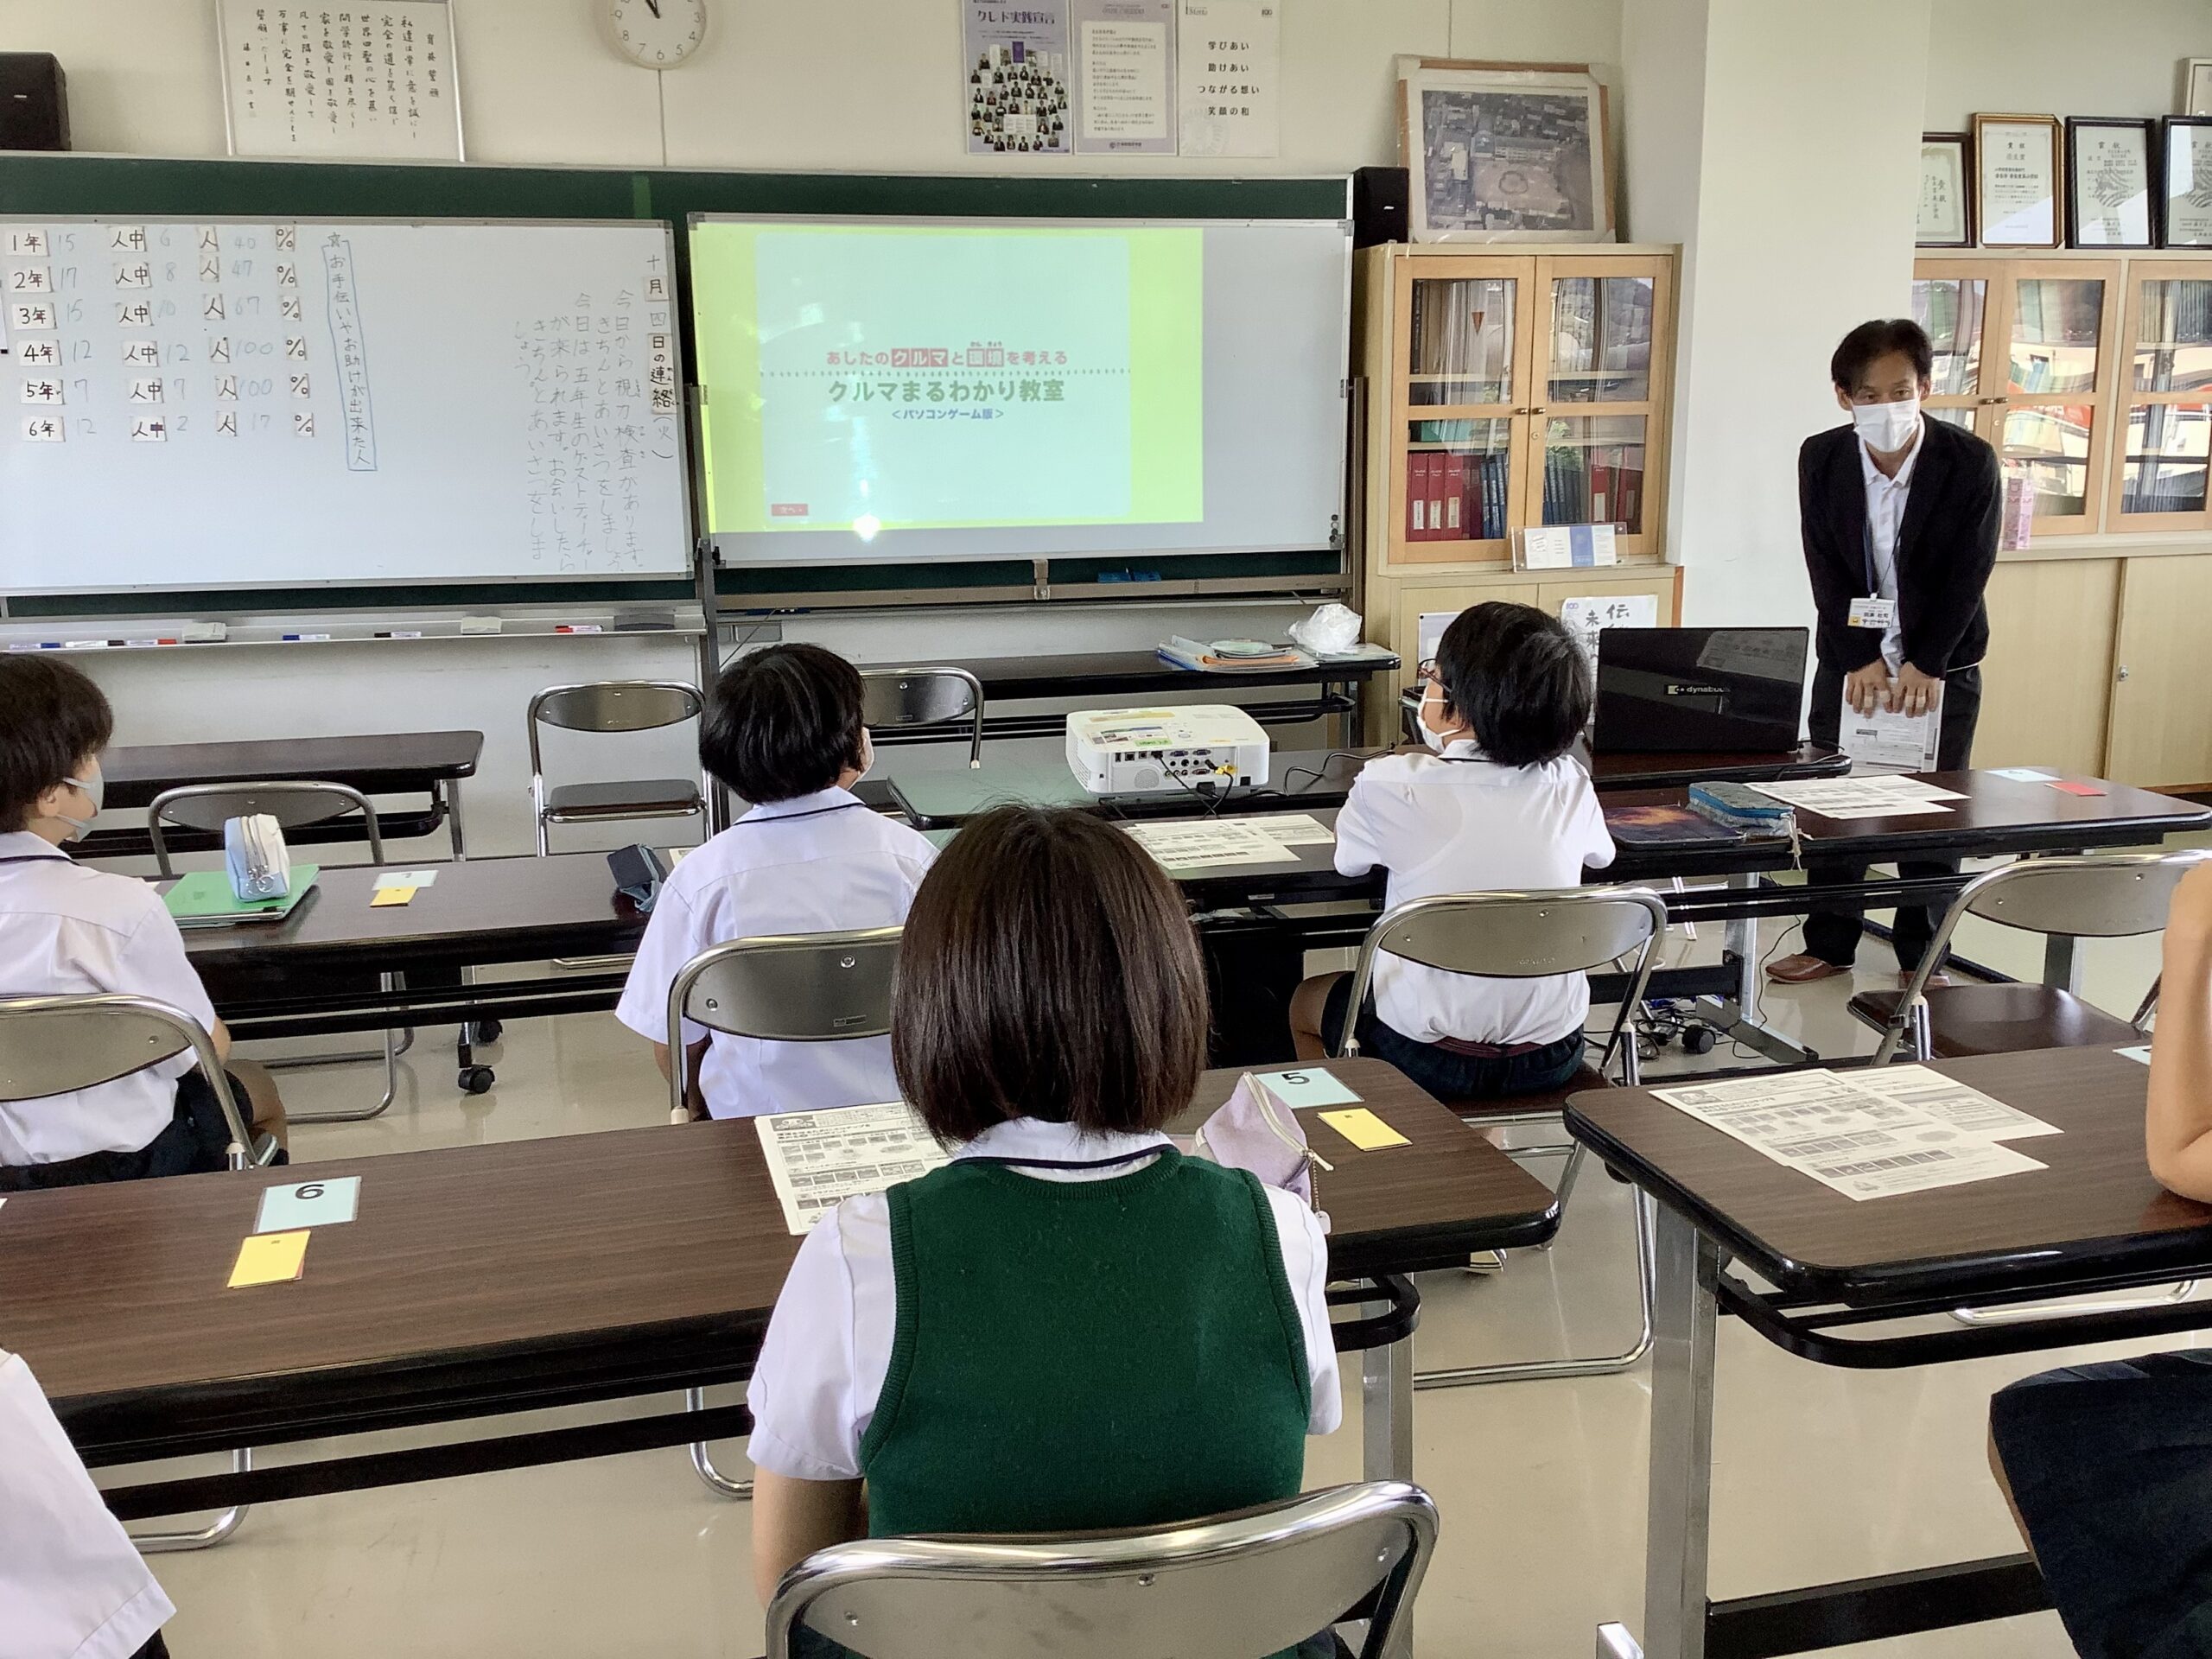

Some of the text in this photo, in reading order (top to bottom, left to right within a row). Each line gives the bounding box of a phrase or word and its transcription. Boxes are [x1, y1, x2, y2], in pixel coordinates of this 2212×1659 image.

[614, 10, 623, 21] 9
[694, 11, 701, 23] 3
[622, 29, 630, 41] 8
[688, 31, 696, 41] 4
[639, 42, 646, 54] 7
[676, 44, 683, 55] 5
[1208, 41, 1249, 51] 学びあい
[656, 49, 664, 60] 6
[1208, 63, 1249, 73] 助けあい
[1198, 85, 1260, 94] つながる想い
[1208, 106, 1249, 116] 笑顔の和
[13, 233, 41, 252] 1年
[111, 230, 143, 250] 人中
[200, 231, 218, 248] 人
[276, 229, 294, 248] %
[14, 270, 42, 289] 2年
[116, 266, 148, 285] 人中
[200, 260, 218, 276] 人
[277, 266, 295, 284] %
[19, 307, 47, 324] 3年
[119, 305, 148, 323] 人中
[204, 297, 223, 315] 人
[283, 301, 299, 318] %
[24, 344, 53, 363] 4年
[124, 346, 155, 363] 人中
[211, 341, 229, 359] 人
[286, 339, 304, 357] %
[27, 380, 54, 400] 5年
[130, 382, 161, 401] 人中
[219, 379, 236, 397] 人
[290, 376, 308, 394] %
[828, 379, 1065, 404] クルマまるわかり教室
[29, 420, 54, 437] 6年
[131, 421, 163, 438] 人中
[218, 415, 236, 433] 人
[295, 415, 312, 432] %
[1281, 1071, 1310, 1085] 5
[295, 1184, 325, 1200] 6
